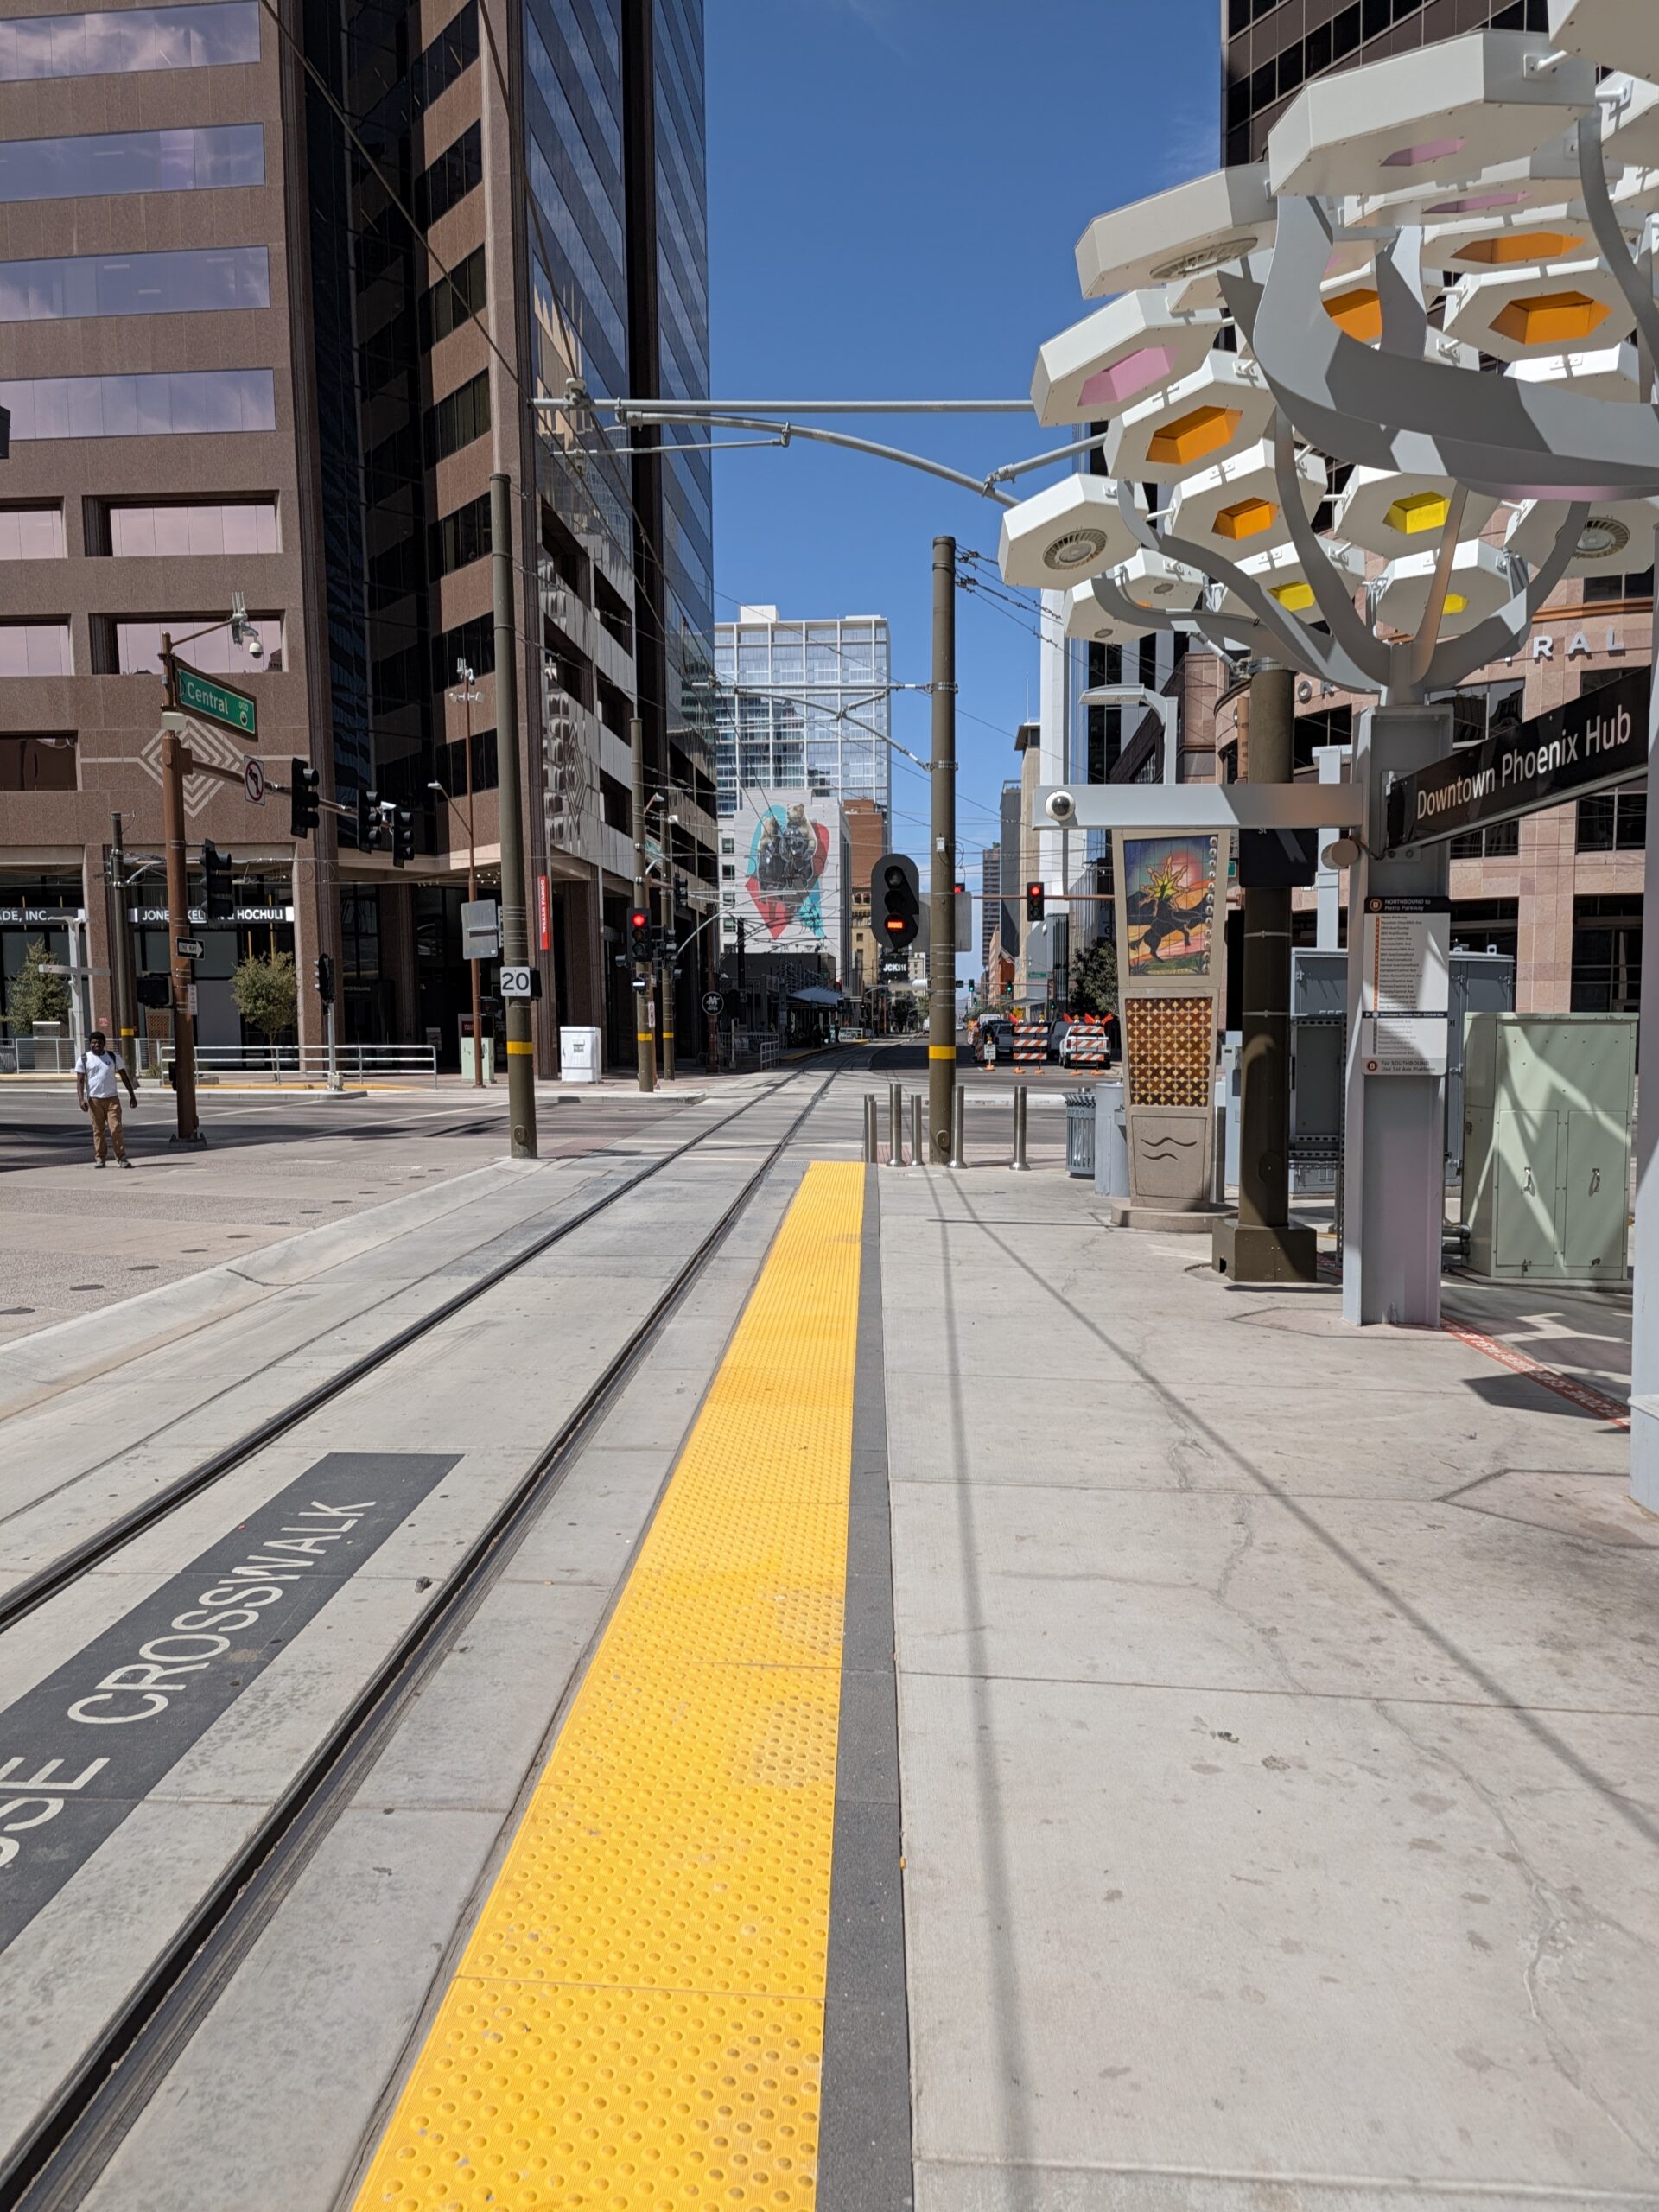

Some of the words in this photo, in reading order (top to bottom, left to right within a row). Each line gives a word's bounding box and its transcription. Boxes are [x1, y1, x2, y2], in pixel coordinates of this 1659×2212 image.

[187, 682, 229, 715] Central
[1417, 766, 1496, 820] Downtown
[1502, 729, 1578, 788] Phoenix
[1586, 704, 1631, 757] Hub
[237, 908, 283, 920] HOCHULI
[188, 944, 197, 954] WAY
[501, 972, 530, 991] 20
[0, 1757, 111, 1868] SE
[67, 1501, 377, 1724] CROSSWALK
